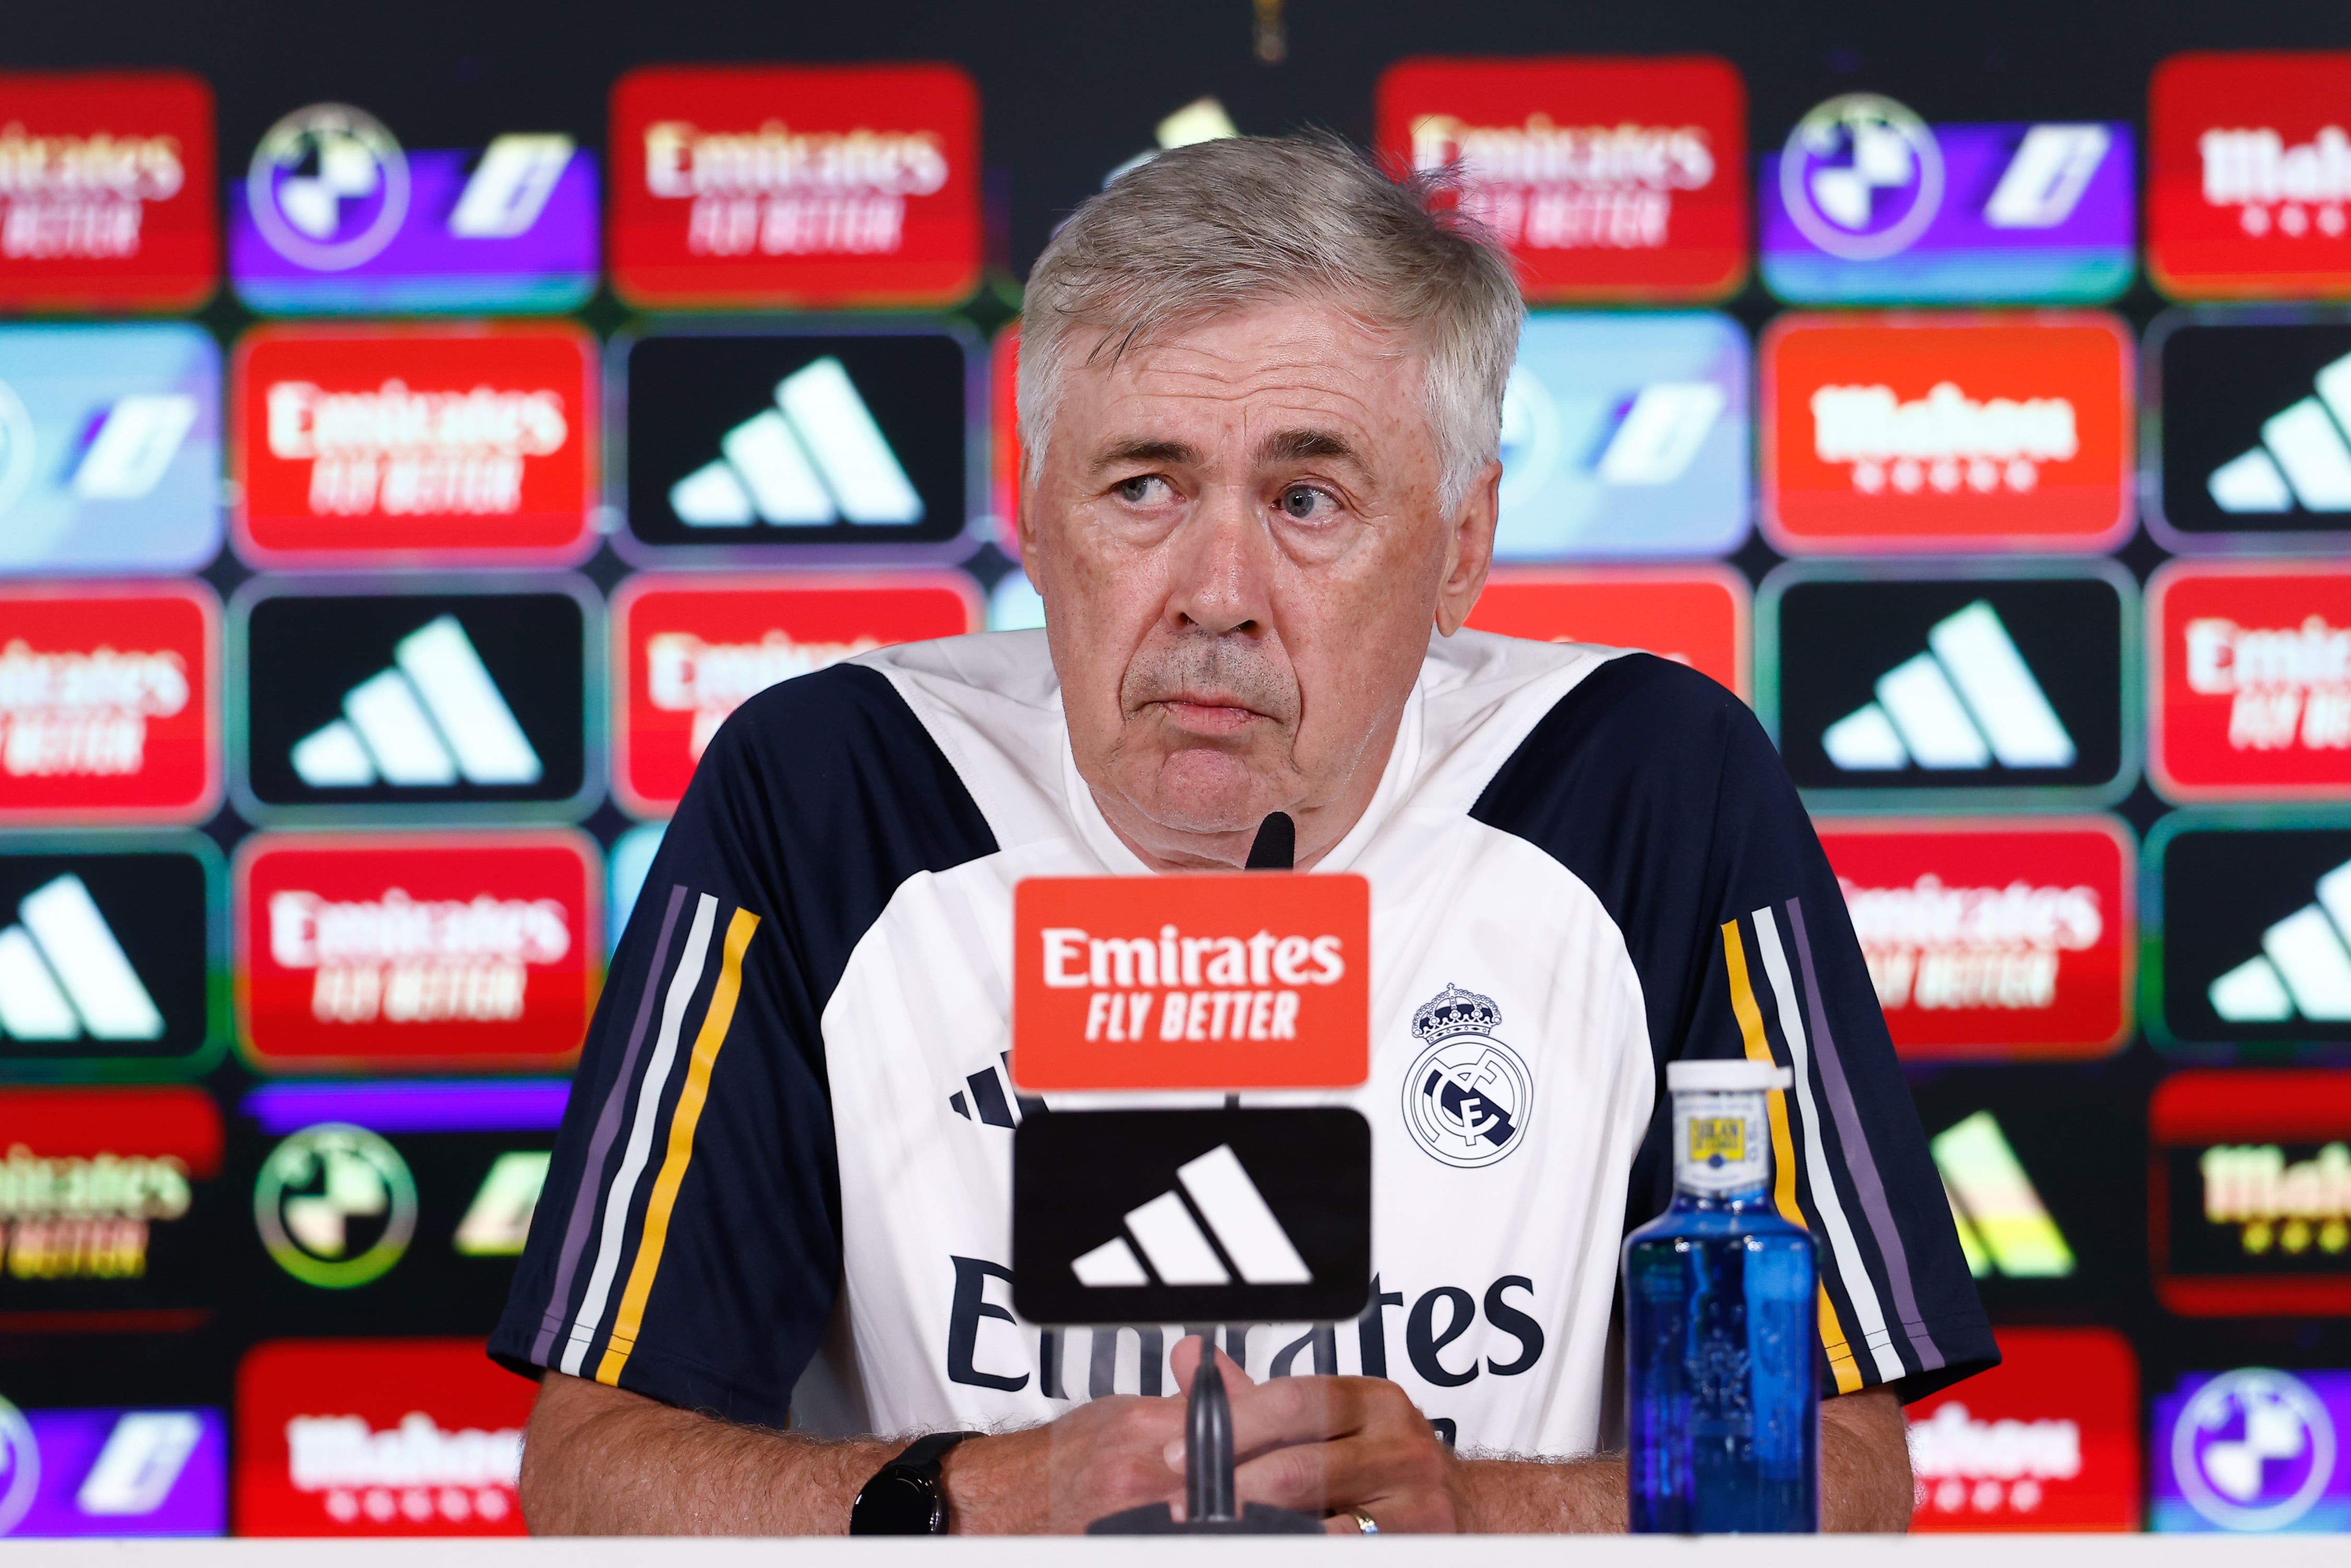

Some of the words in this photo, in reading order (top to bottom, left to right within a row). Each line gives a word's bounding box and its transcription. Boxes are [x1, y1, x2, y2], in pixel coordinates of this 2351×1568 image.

[0, 123, 183, 201] irates
[645, 119, 947, 196] Emirates
[267, 378, 568, 459] Emirates
[0, 638, 190, 718] irates
[269, 887, 570, 968] Emirates
[1836, 872, 2102, 951] mirates
[1041, 924, 1346, 987] Emirates
[1085, 992, 1153, 1041] FLY
[1159, 991, 1300, 1041] BETTER
[0, 1142, 192, 1221] irates
[948, 1255, 1544, 1400] Emates
